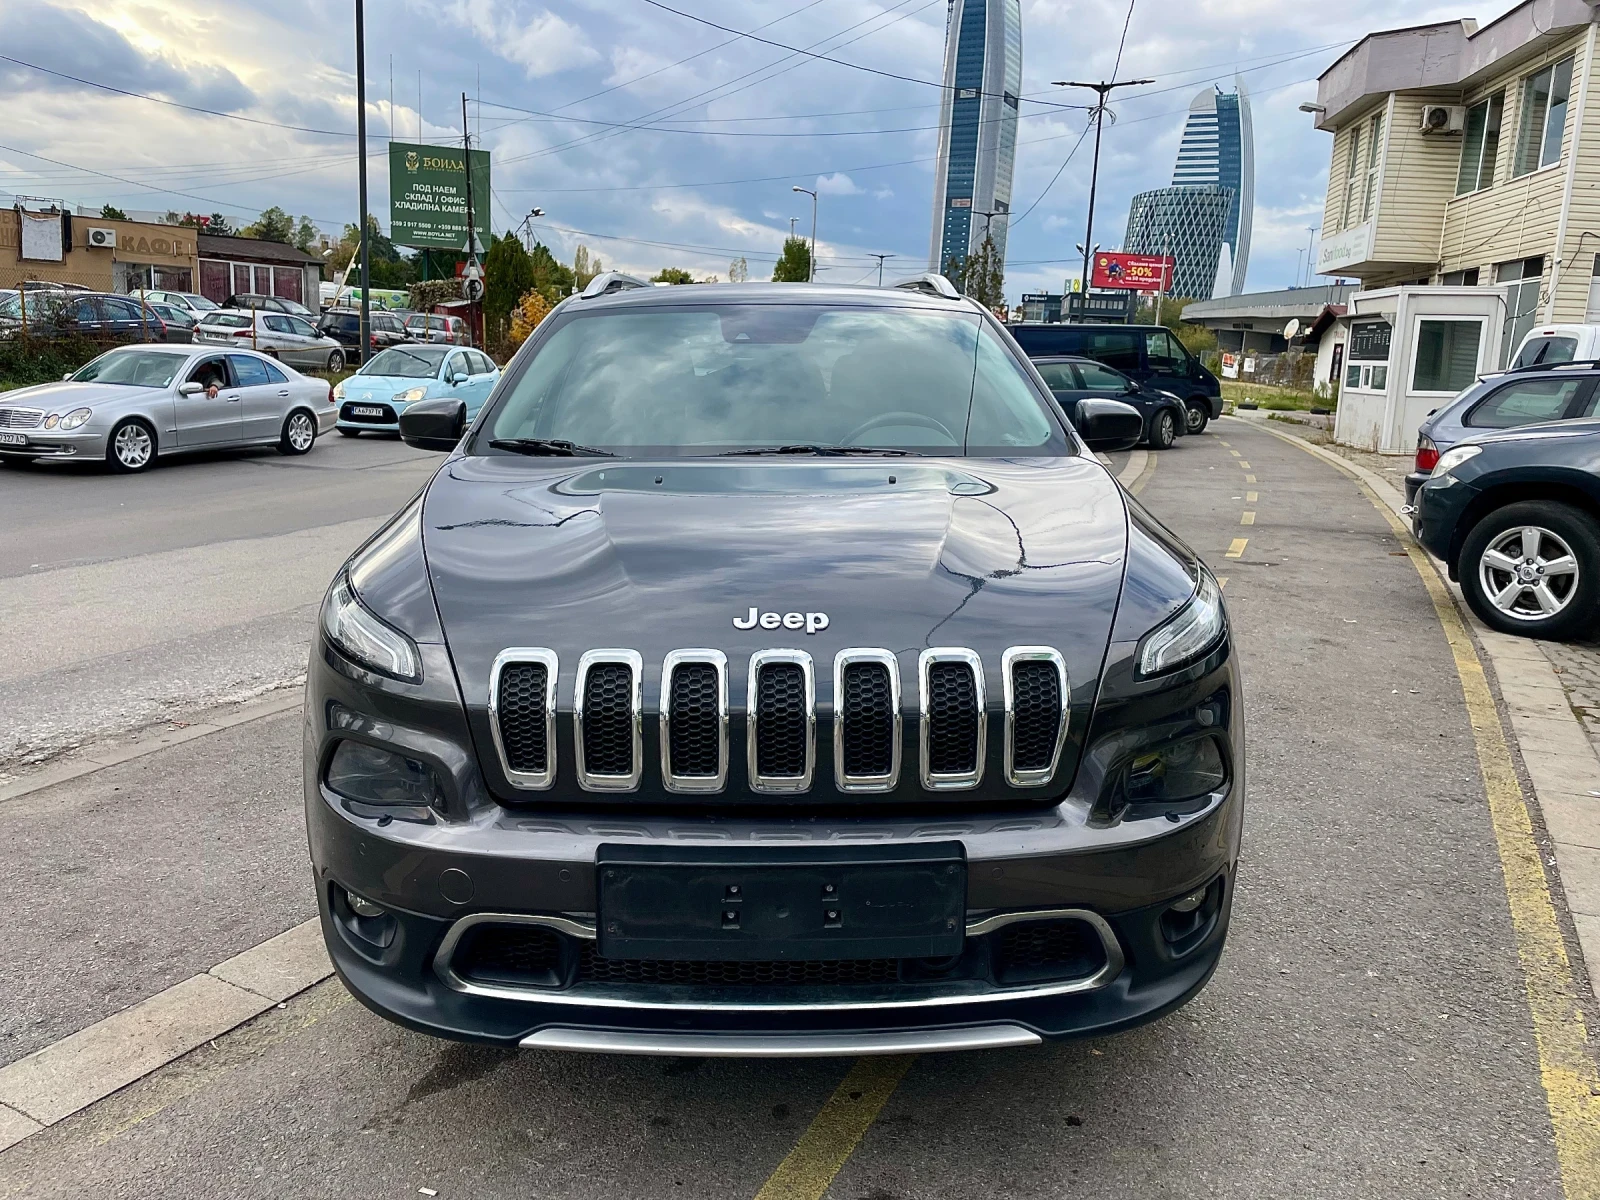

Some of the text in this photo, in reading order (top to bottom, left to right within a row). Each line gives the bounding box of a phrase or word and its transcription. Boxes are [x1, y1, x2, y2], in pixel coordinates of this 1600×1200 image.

[423, 157, 465, 170] БОИЛА
[412, 183, 457, 194] ПОД НАЕМ
[404, 192, 433, 203] СКЛАД
[440, 195, 466, 205] ОФИС
[394, 201, 440, 212] ХЛАДИЛНА
[121, 235, 183, 256] КАФЕ
[1126, 266, 1153, 277] -50%
[732, 607, 830, 635] Jeep
